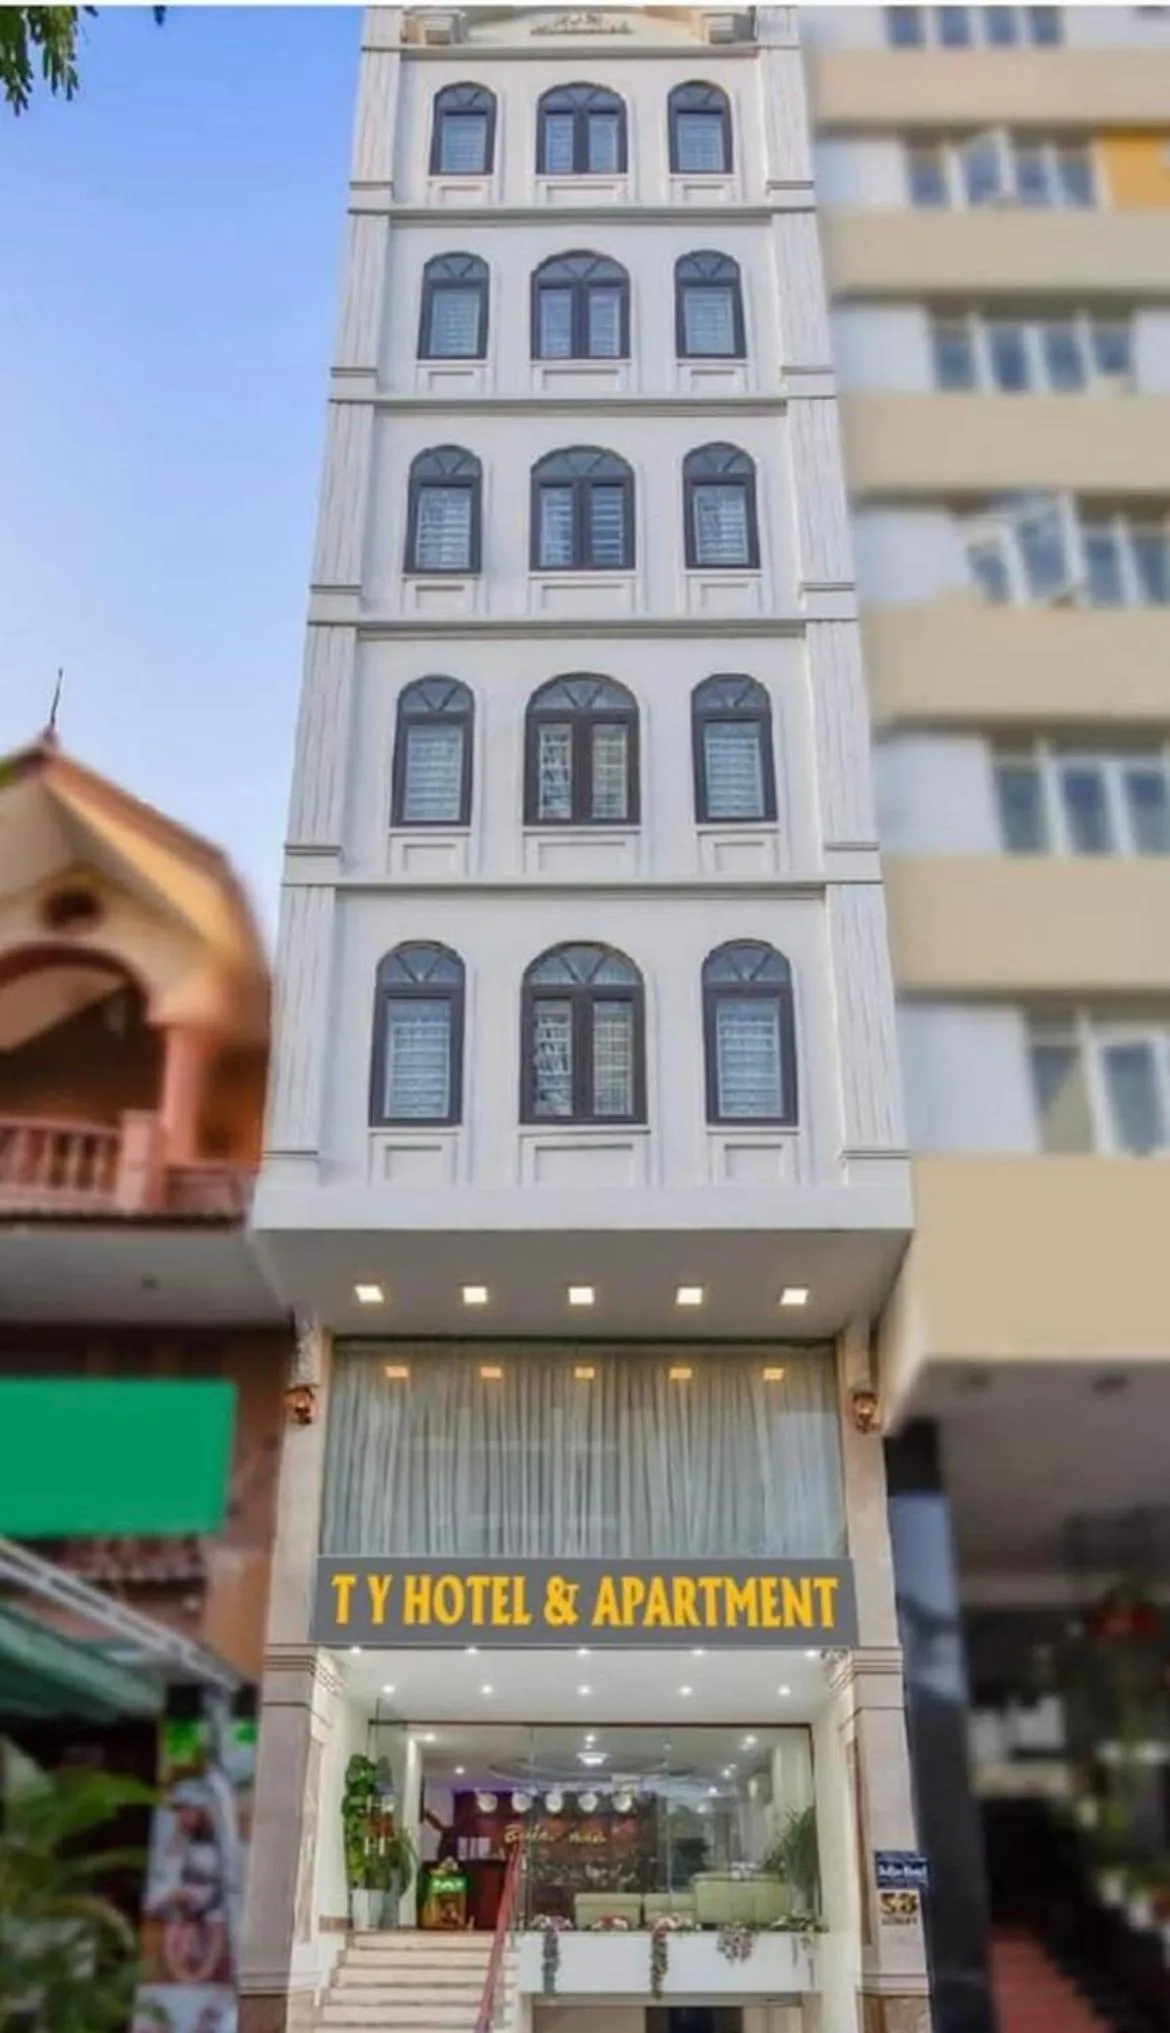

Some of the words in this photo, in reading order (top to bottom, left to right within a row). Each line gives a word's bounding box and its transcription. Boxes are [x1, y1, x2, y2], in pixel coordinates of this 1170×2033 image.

[331, 1572, 357, 1625] T
[365, 1573, 393, 1626] Y
[401, 1574, 533, 1628] HOTEL
[542, 1574, 580, 1629] &
[590, 1574, 840, 1630] APARTMENT
